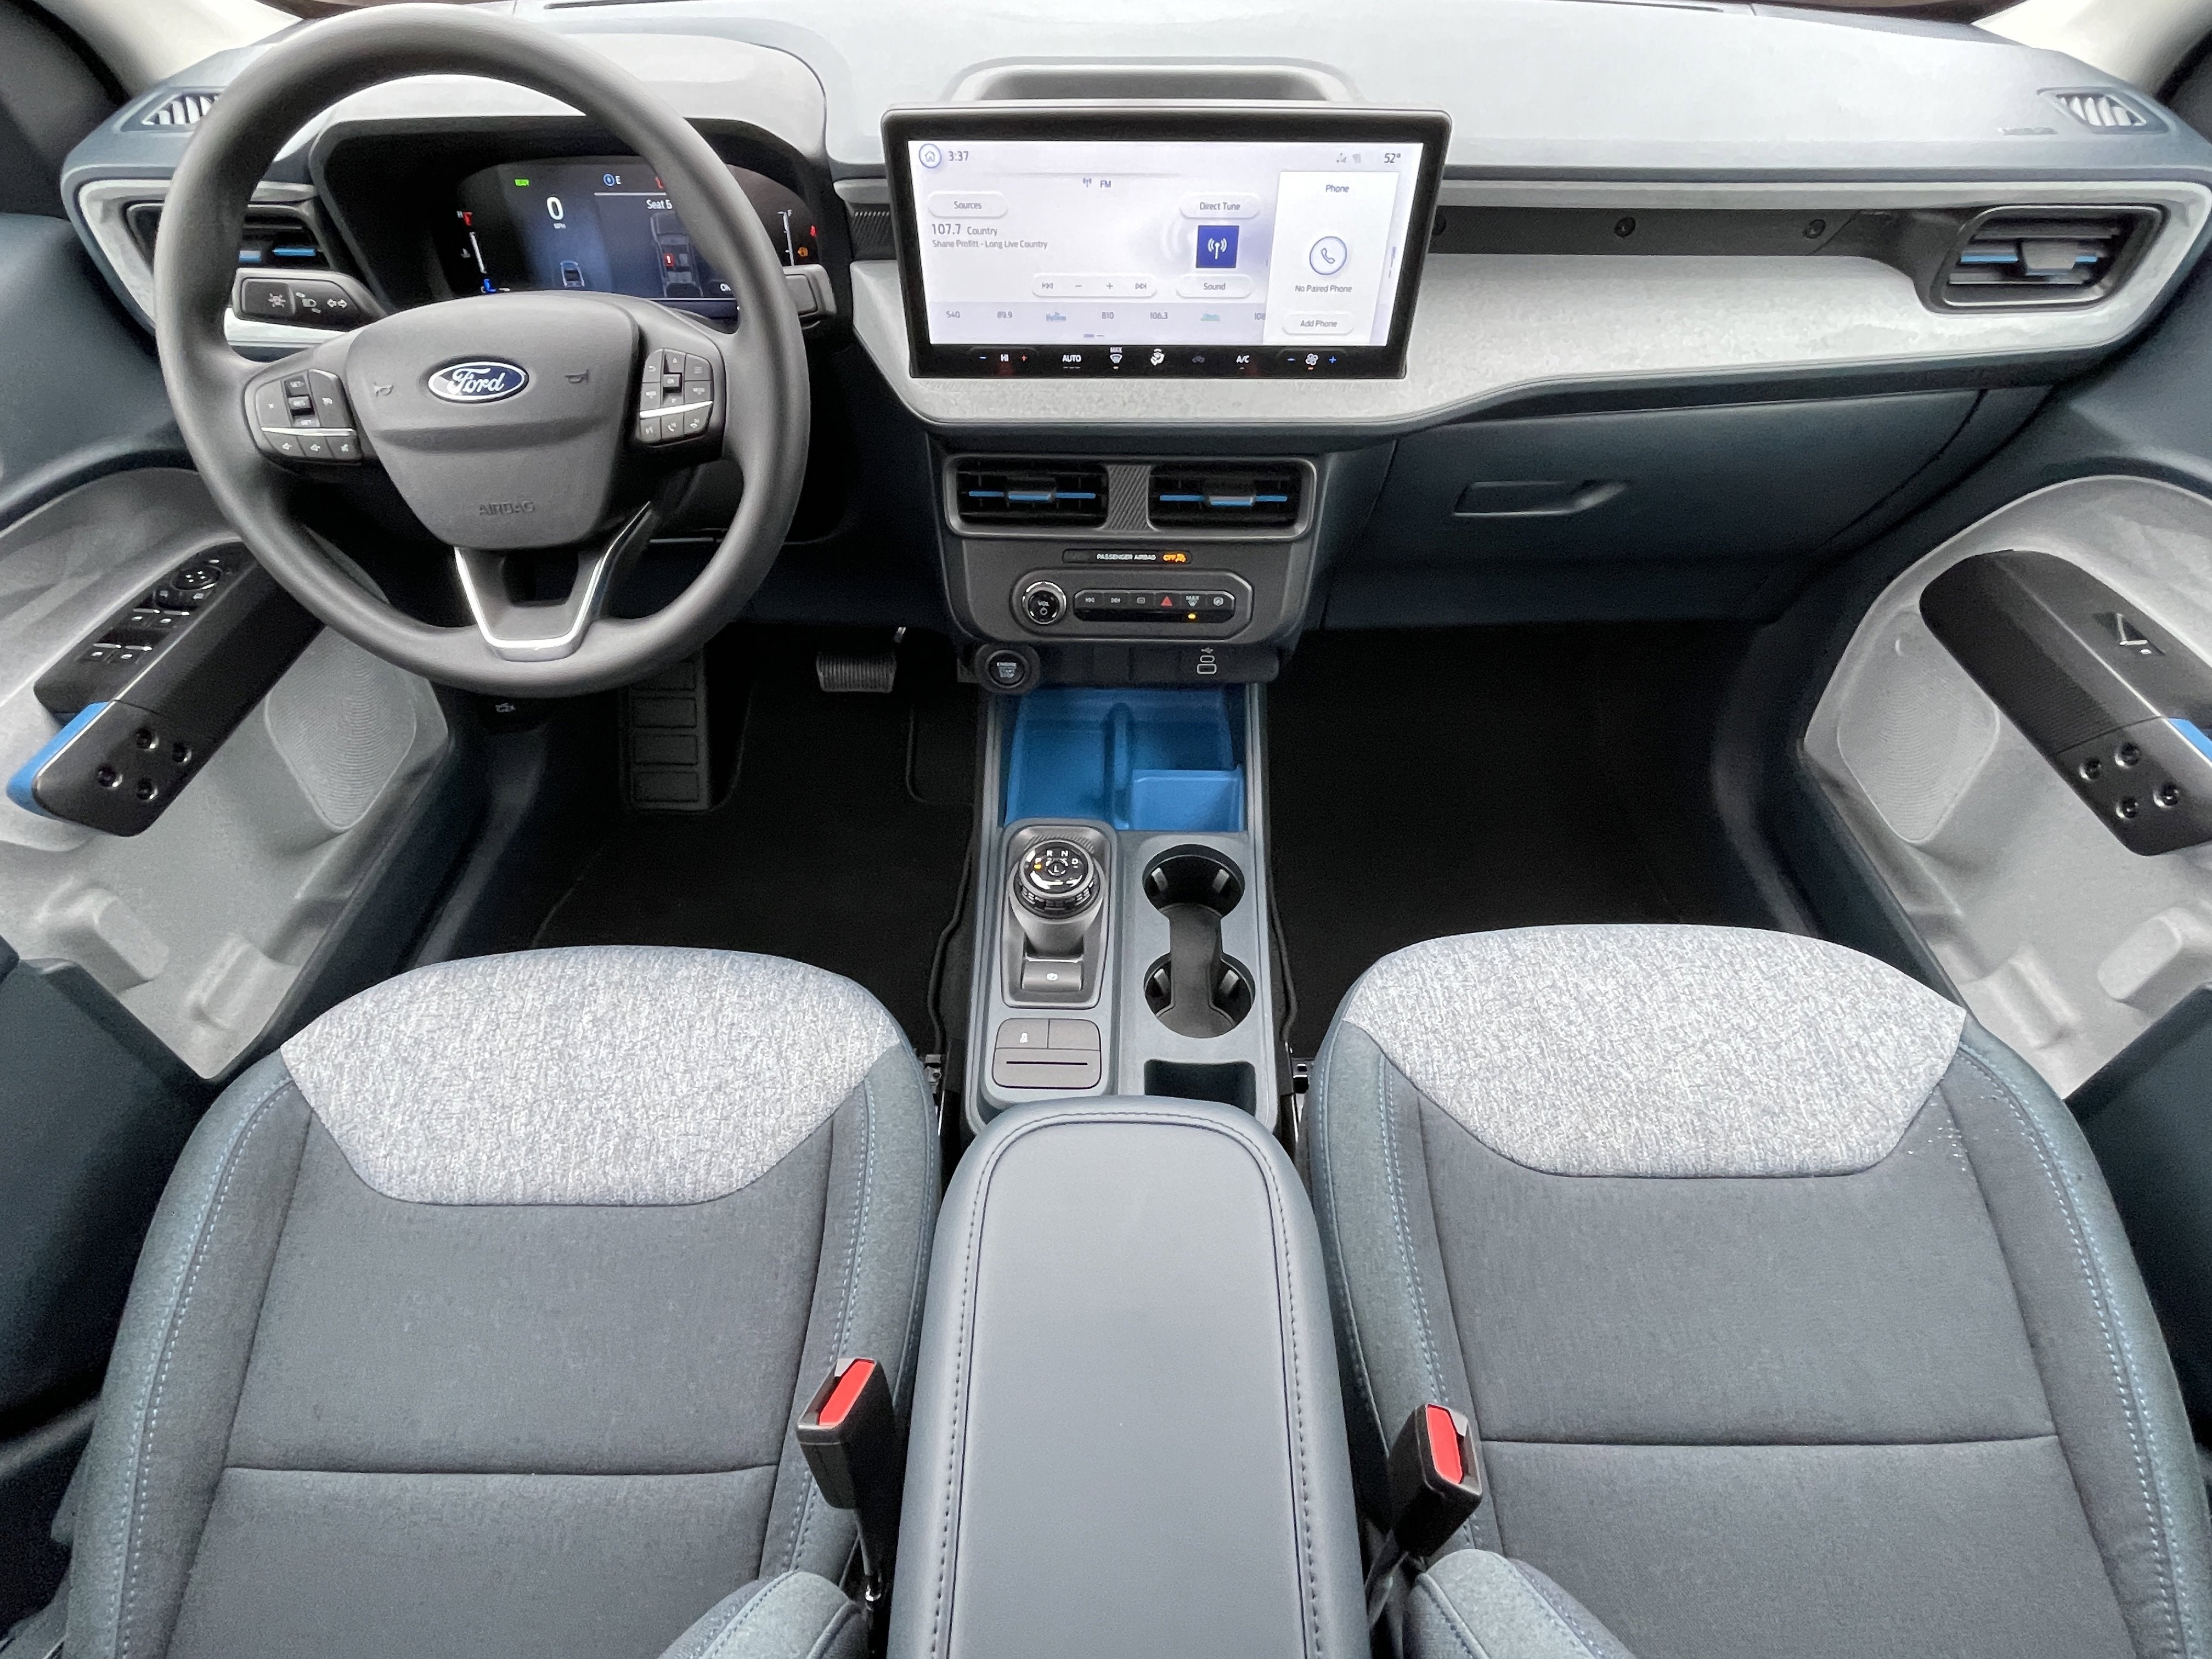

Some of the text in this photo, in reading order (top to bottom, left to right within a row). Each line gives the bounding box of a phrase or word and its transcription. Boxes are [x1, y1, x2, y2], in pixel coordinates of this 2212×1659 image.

[948, 151, 969, 162] 3:37
[1100, 180, 1111, 189] FM
[1325, 184, 1350, 193] Phone
[546, 196, 565, 221] 0
[646, 199, 665, 210] Seat
[953, 201, 982, 210] Sources
[1200, 201, 1240, 211] Direct Tune
[932, 224, 998, 236] 107.7 Country
[985, 241, 1003, 249] Long
[1020, 240, 1048, 249] Country
[1203, 282, 1226, 291] Sound
[1295, 284, 1352, 293] No Paired Phone
[1300, 319, 1338, 328] Add Phone
[447, 368, 505, 395] Ford
